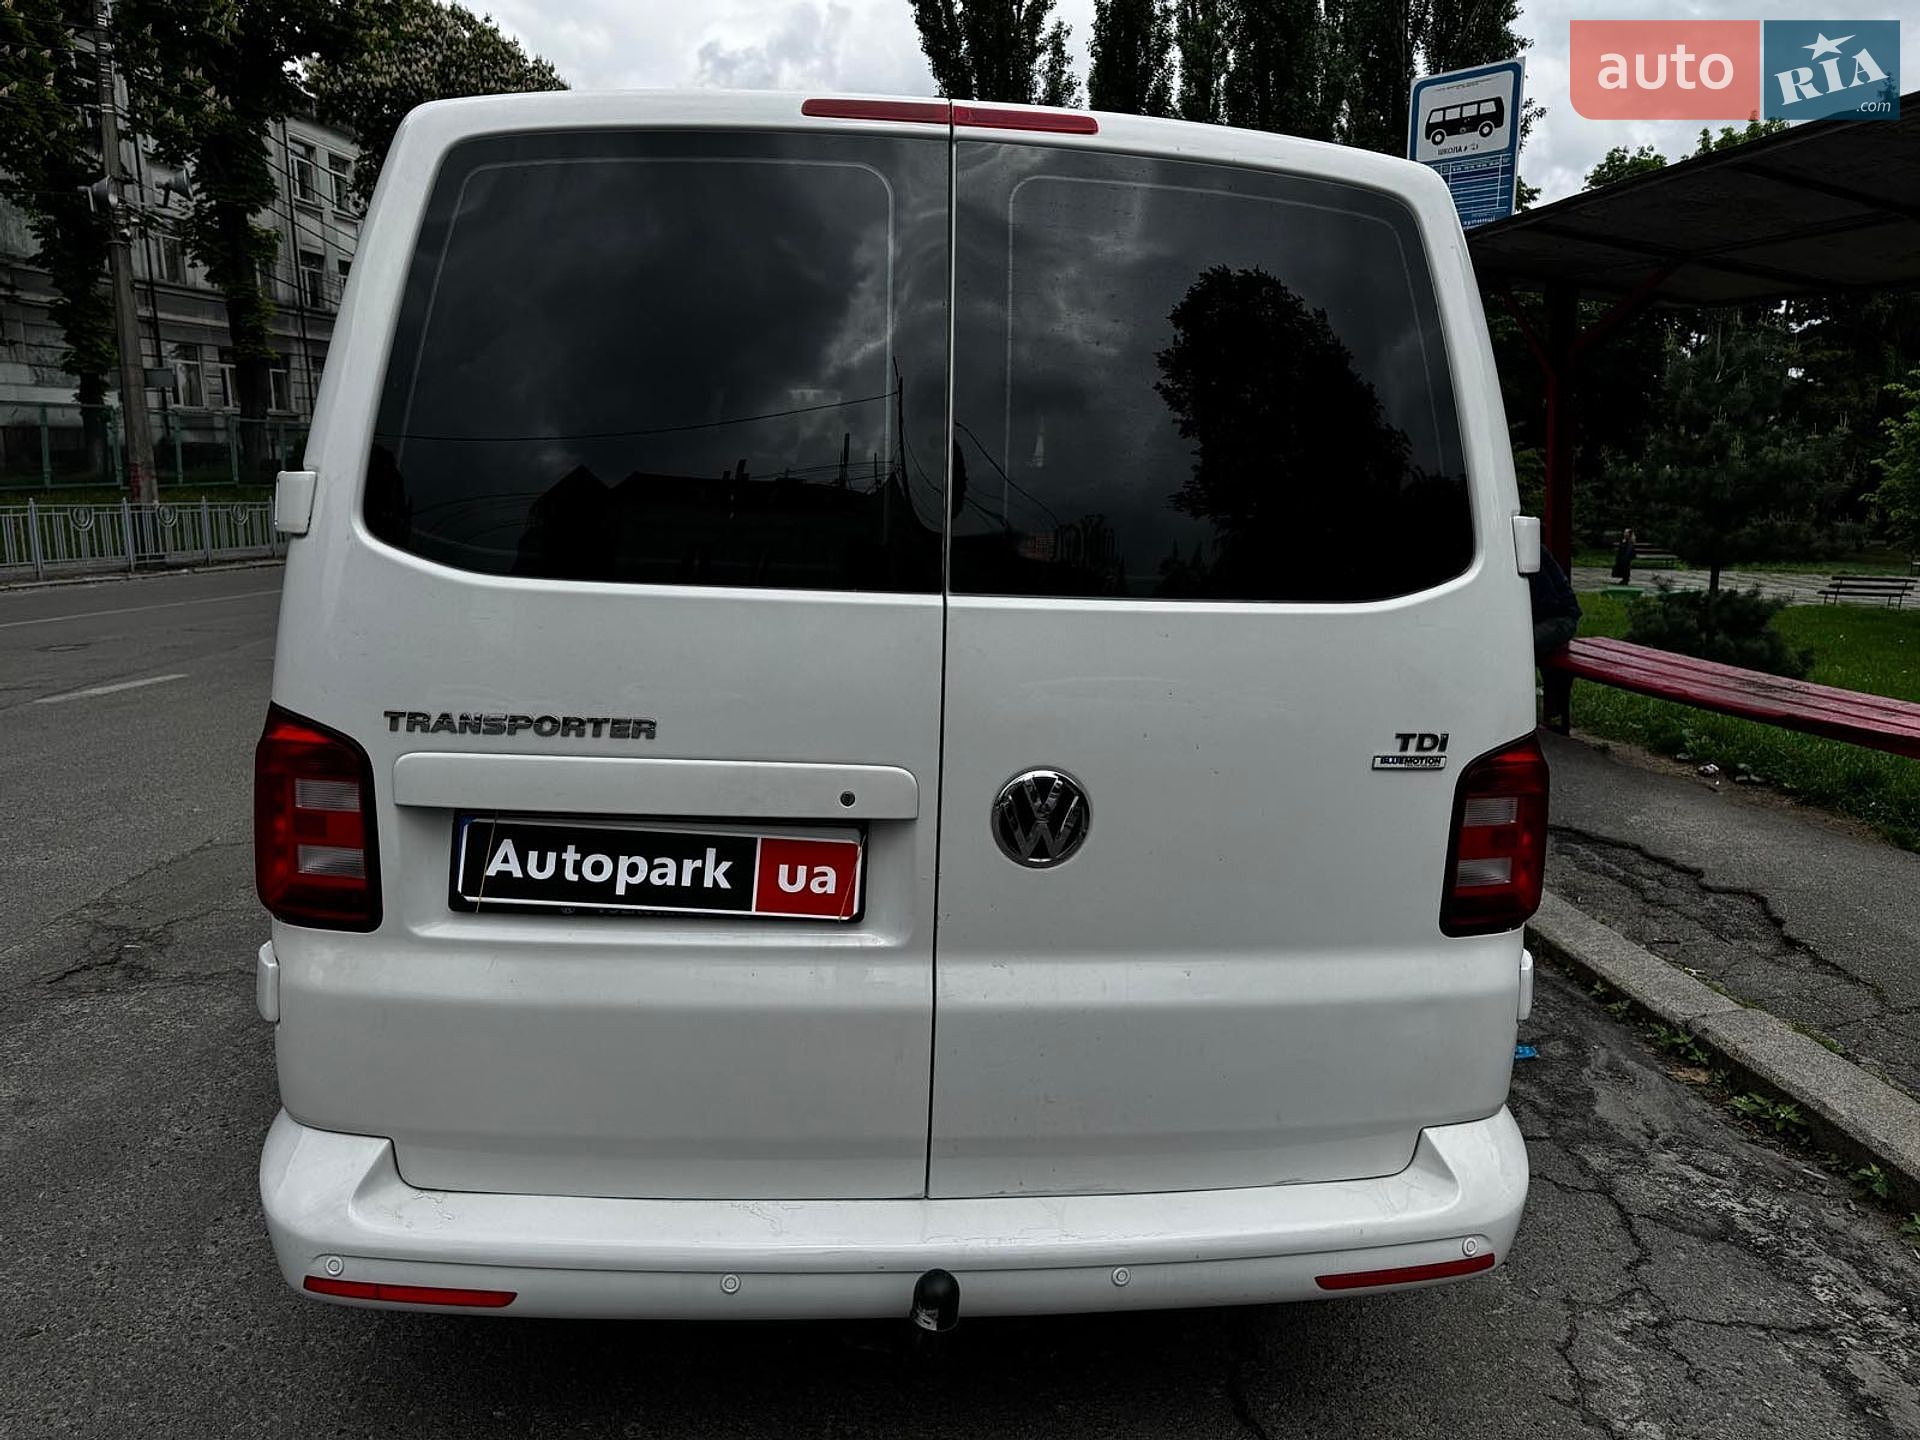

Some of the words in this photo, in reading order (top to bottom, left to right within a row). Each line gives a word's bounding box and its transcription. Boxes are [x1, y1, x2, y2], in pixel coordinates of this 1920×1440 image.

[383, 710, 658, 740] TRANSPORTER
[1379, 756, 1442, 766] BLUEMOTION
[485, 837, 734, 896] Autopark
[776, 862, 837, 895] ua
